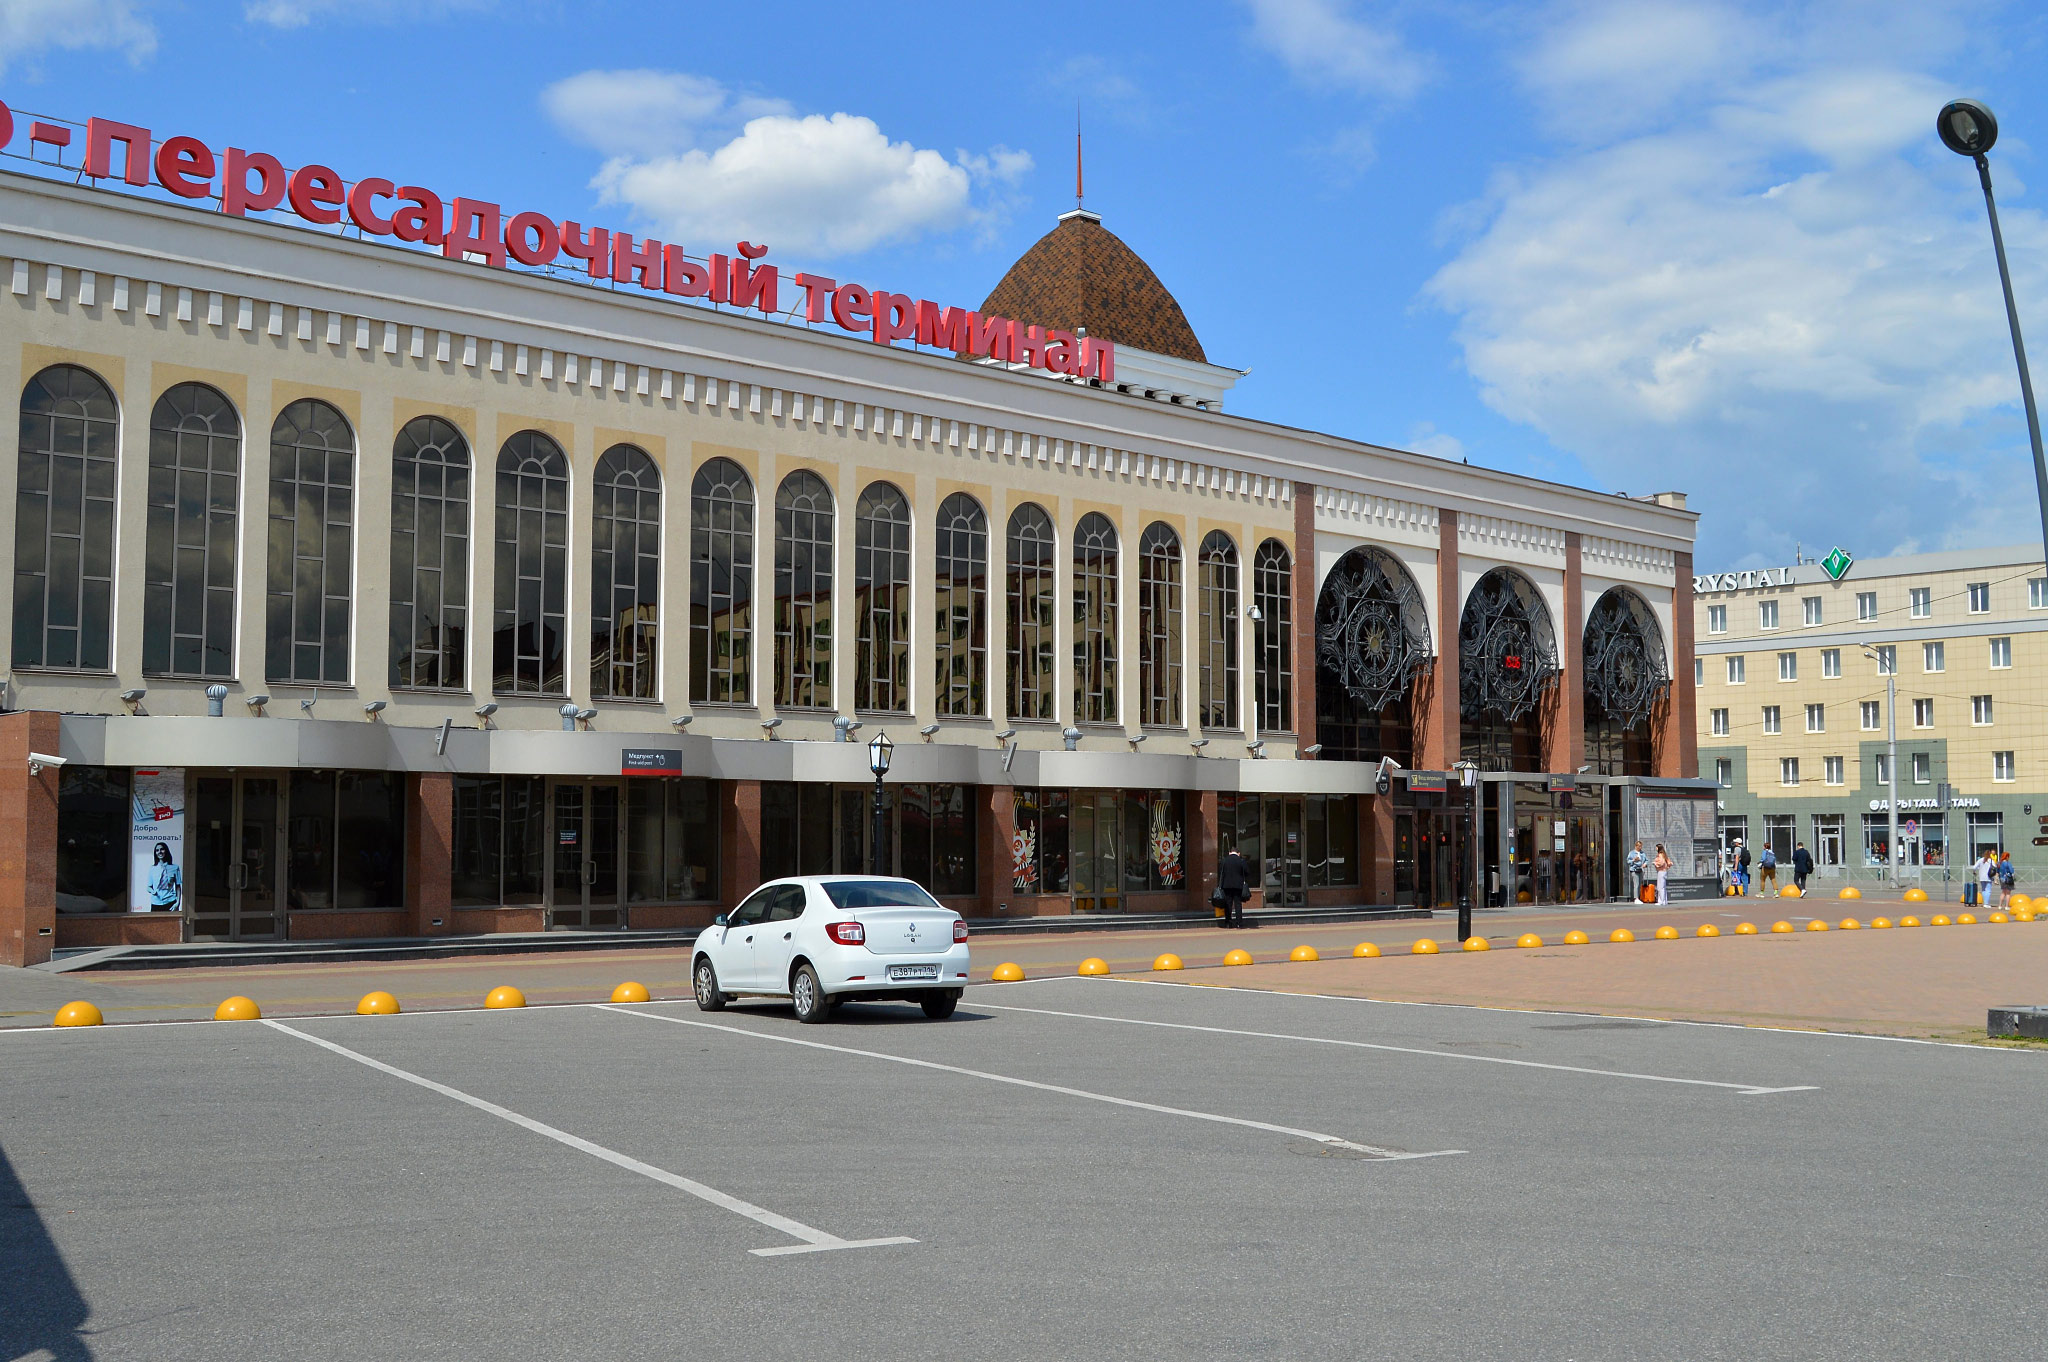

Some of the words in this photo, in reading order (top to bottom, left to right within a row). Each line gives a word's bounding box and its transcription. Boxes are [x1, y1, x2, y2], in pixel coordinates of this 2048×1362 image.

[0, 98, 778, 313] -пересадочный
[795, 272, 1115, 383] терминал
[1913, 798, 1981, 808] ТАТАТАНА
[133, 824, 158, 832] Добро
